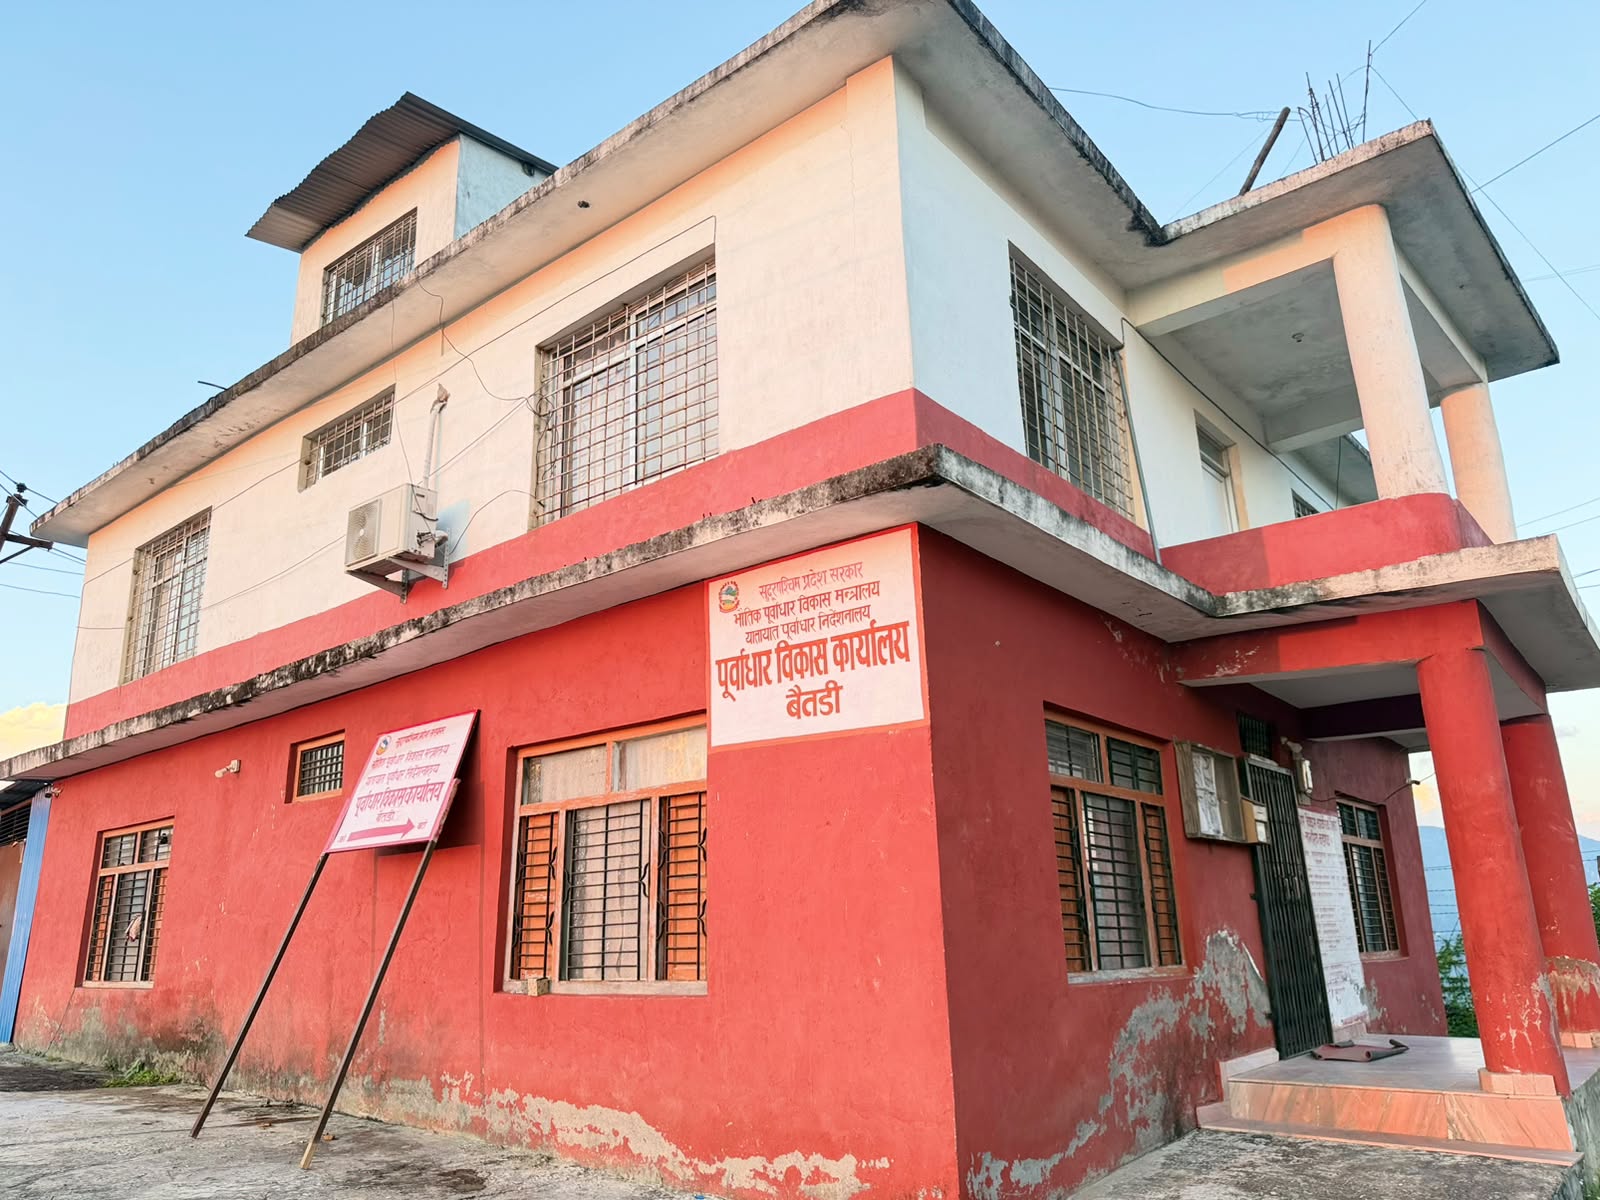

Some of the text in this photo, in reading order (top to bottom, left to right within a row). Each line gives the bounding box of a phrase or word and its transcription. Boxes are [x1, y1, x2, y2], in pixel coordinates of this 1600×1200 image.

[802, 569, 827, 590] प्रदेश
[829, 562, 863, 582] सरकार
[763, 601, 796, 624] पूर्वाधार
[797, 594, 832, 613] विकास
[834, 581, 880, 604] मन्त्रालय
[745, 625, 779, 644] यातायात
[818, 604, 871, 630] निर्देशनालय
[715, 619, 911, 702] पूर्वाधार विकास कार्यालय
[786, 680, 844, 720] बैतडी
